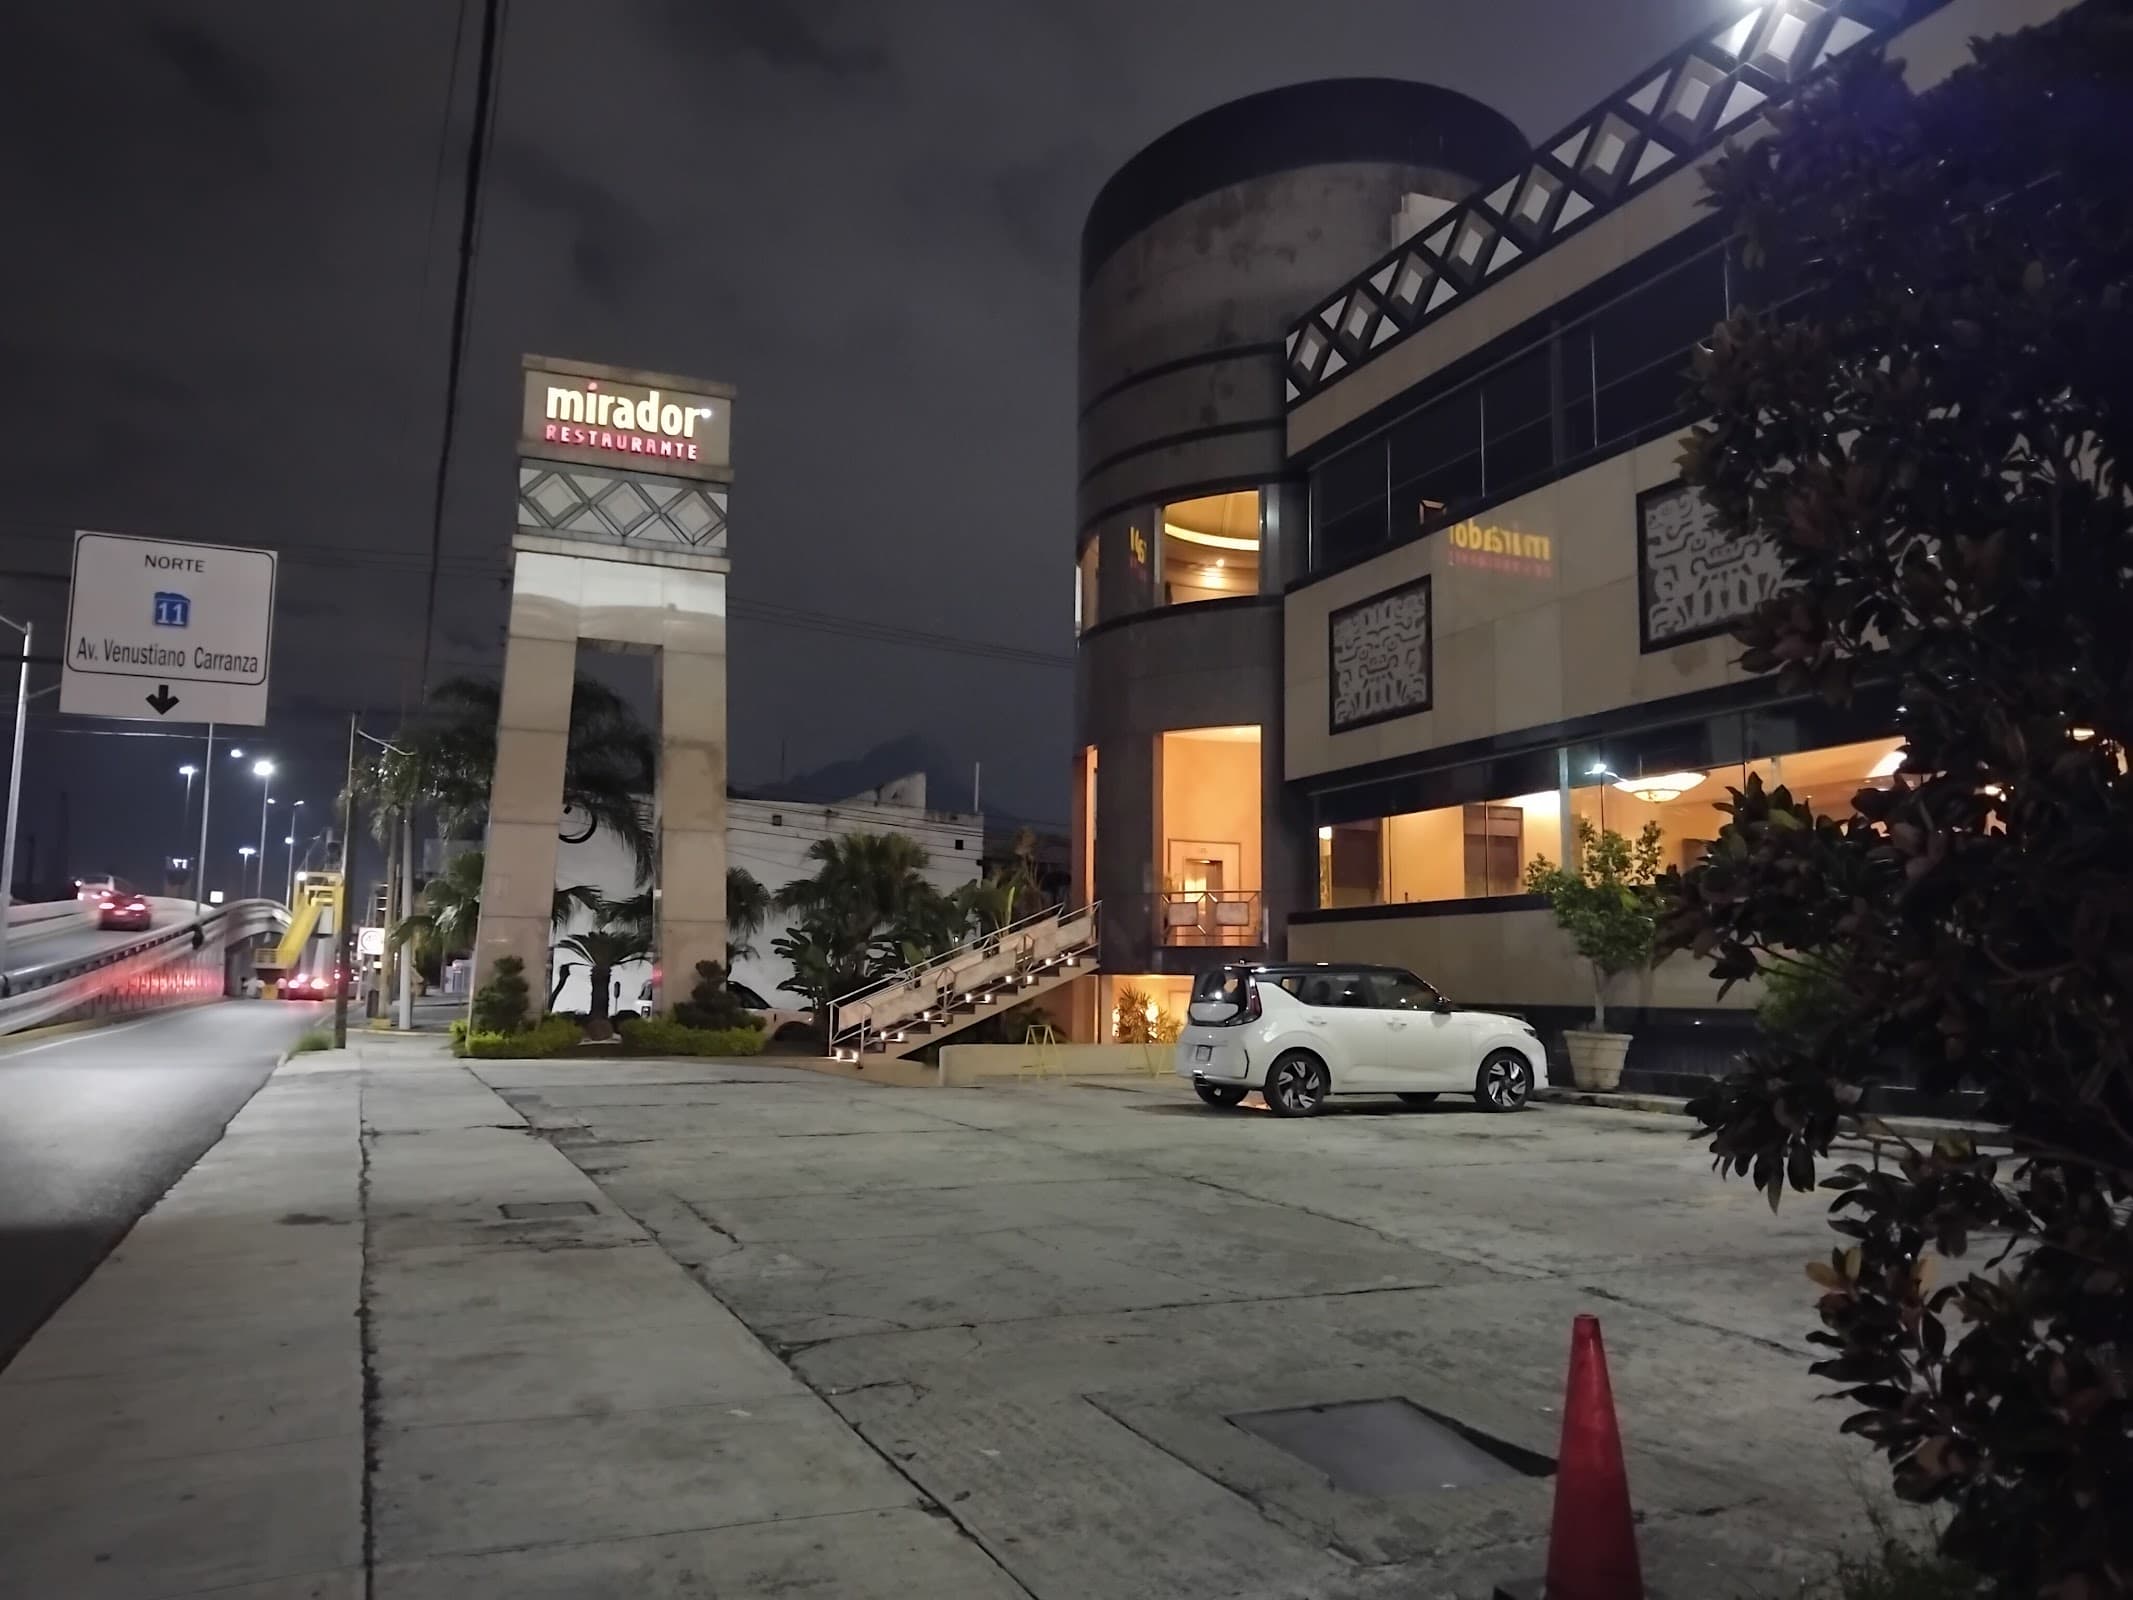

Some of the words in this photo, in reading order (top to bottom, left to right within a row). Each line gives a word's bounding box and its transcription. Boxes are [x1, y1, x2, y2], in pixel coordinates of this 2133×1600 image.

[546, 382, 705, 438] mirador
[545, 424, 698, 461] RESTAURANTE
[144, 554, 206, 573] NORTE
[157, 602, 186, 626] 11
[76, 636, 99, 662] Av.
[103, 639, 186, 668] Venustiano
[193, 647, 259, 674] Carranza
